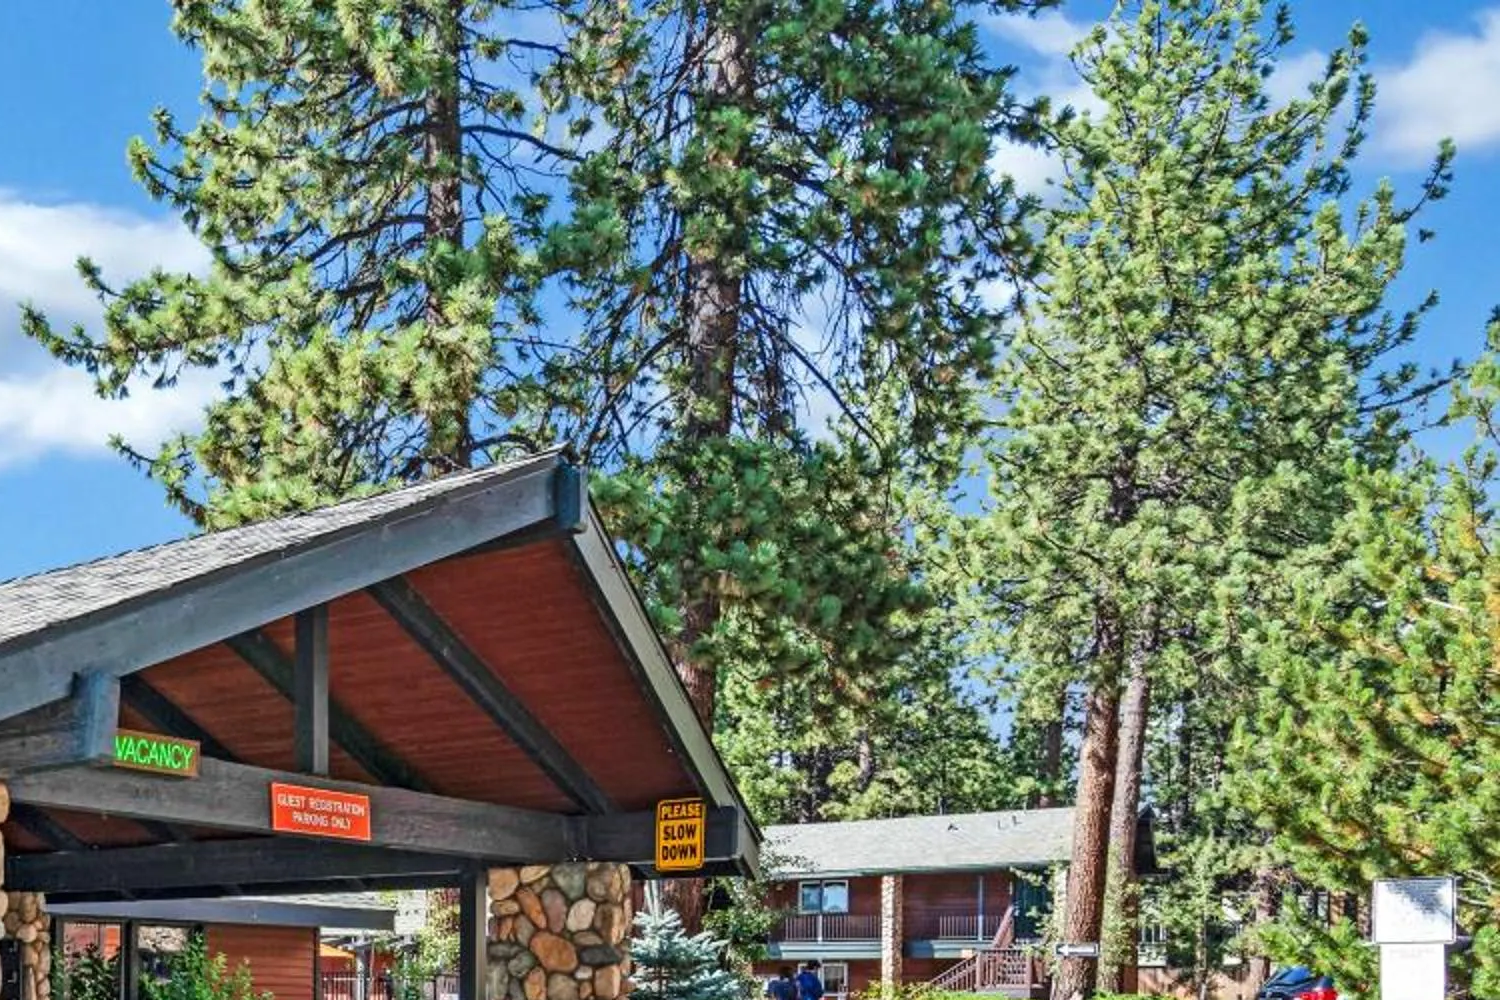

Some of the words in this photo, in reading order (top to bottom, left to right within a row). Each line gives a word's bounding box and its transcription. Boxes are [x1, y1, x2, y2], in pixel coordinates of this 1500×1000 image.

[115, 735, 196, 769] VACANCY
[277, 793, 305, 808] GUEST
[661, 803, 702, 819] PLEASE
[331, 815, 351, 830] ONLY
[663, 824, 697, 841] SLOW
[661, 844, 697, 861] DOWN
